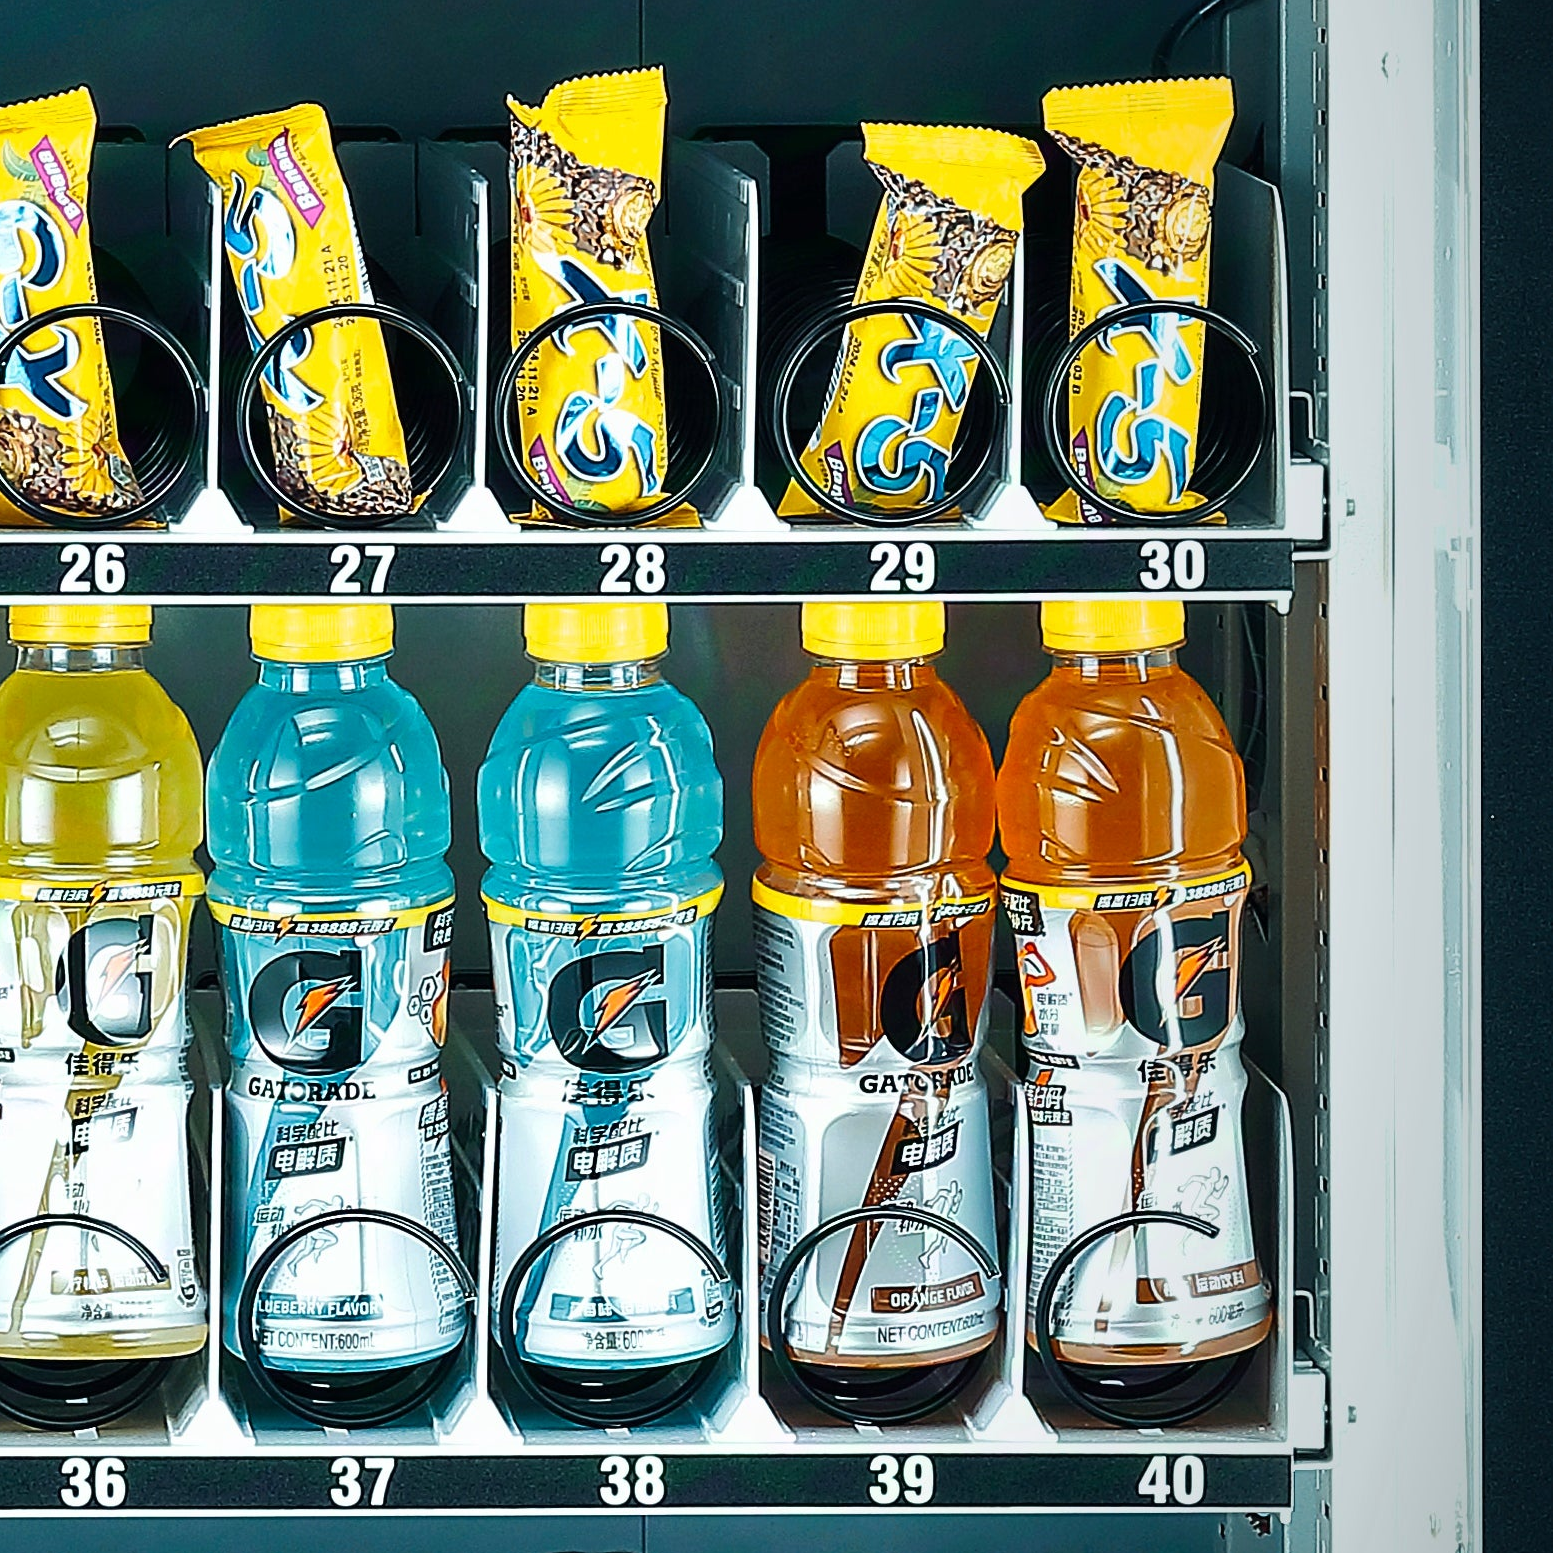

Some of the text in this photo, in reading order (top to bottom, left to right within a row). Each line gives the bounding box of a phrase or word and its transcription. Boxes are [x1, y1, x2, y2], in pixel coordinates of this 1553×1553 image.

[60, 544, 125, 592] 26
[330, 545, 395, 592] 27
[601, 544, 665, 592] 28
[871, 543, 934, 591] 29
[1140, 543, 1204, 589] 30
[66, 1052, 139, 1076] 佳得乐
[249, 1077, 376, 1102] GATORADE
[276, 1121, 340, 1143] 科学配比
[274, 1145, 338, 1173] 电解质
[574, 1141, 644, 1175] 电解质
[327, 1297, 377, 1316] FLAVOR
[890, 1291, 945, 1308] ORANGE
[877, 1327, 906, 1344] NET
[61, 1458, 125, 1506] 36
[331, 1458, 394, 1506] 37
[600, 1457, 664, 1505] 38
[870, 1457, 933, 1503] 39
[1139, 1457, 1203, 1504] 40
